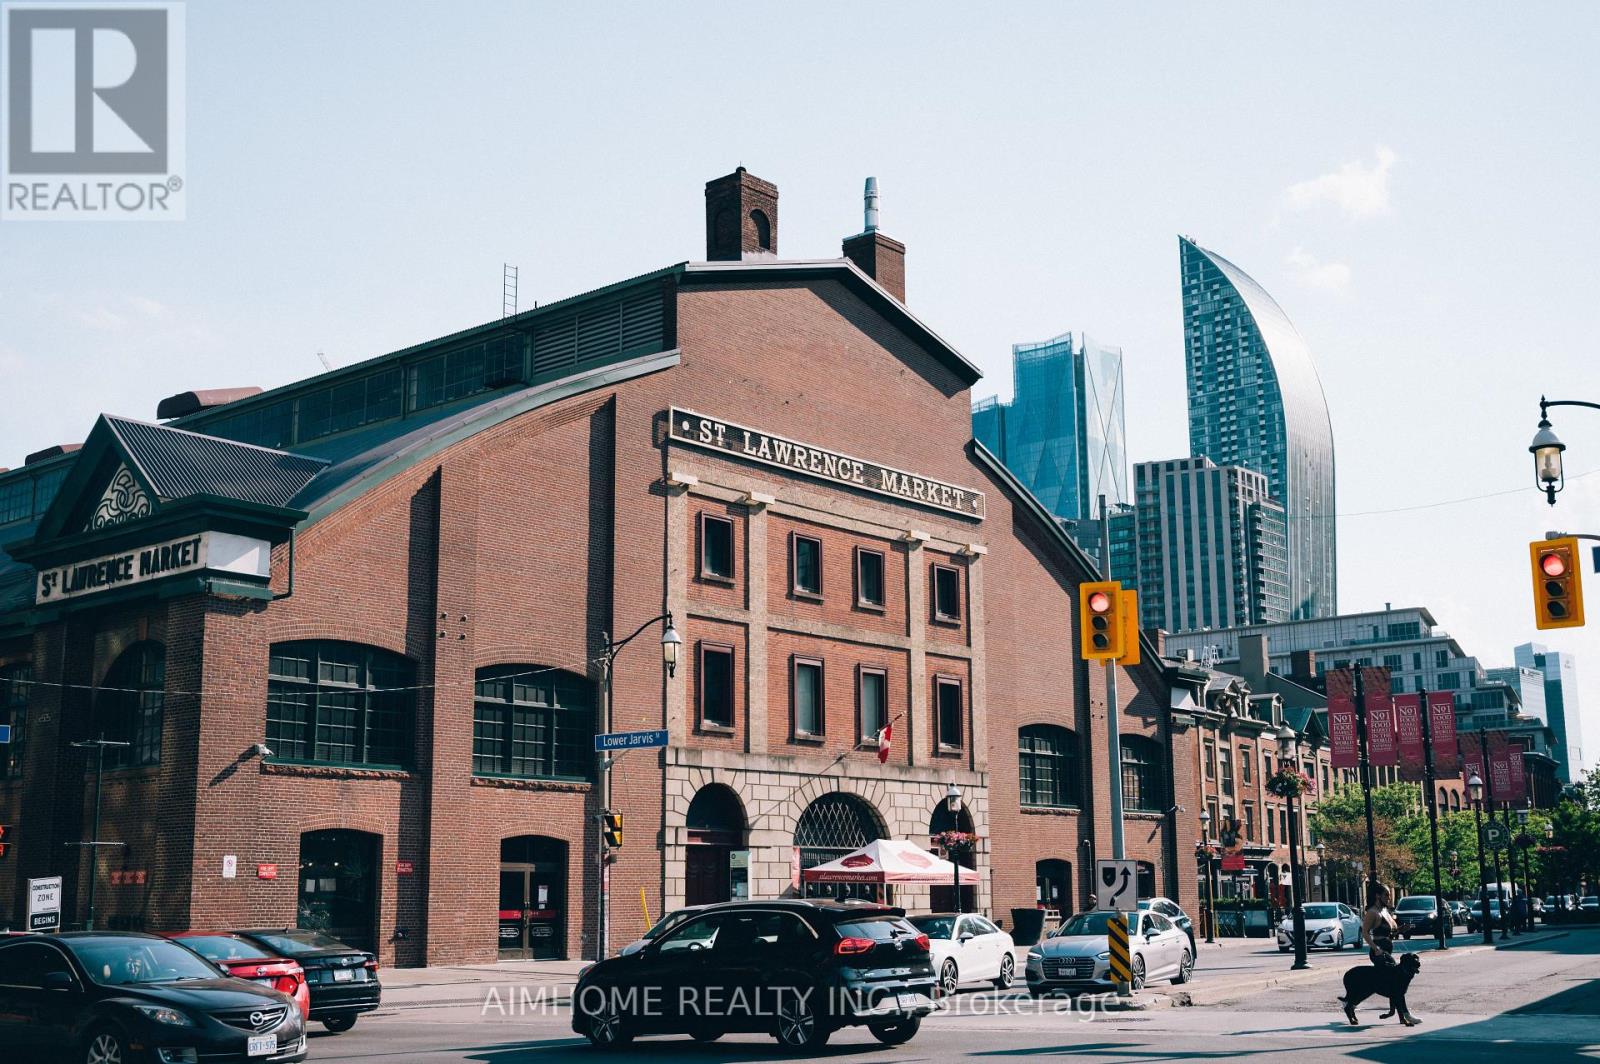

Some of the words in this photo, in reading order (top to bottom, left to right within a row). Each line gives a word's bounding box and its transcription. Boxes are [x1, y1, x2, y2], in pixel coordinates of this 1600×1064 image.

[743, 431, 864, 484] LAWRENCE
[880, 469, 964, 509] MARKET
[62, 555, 134, 594] LAWRENCE
[139, 537, 202, 576] MARKET
[603, 736, 627, 747] Lower
[629, 733, 653, 745] Jarvis
[1488, 829, 1499, 840] P
[37, 893, 54, 902] ZONE
[34, 916, 56, 926] BEGINS
